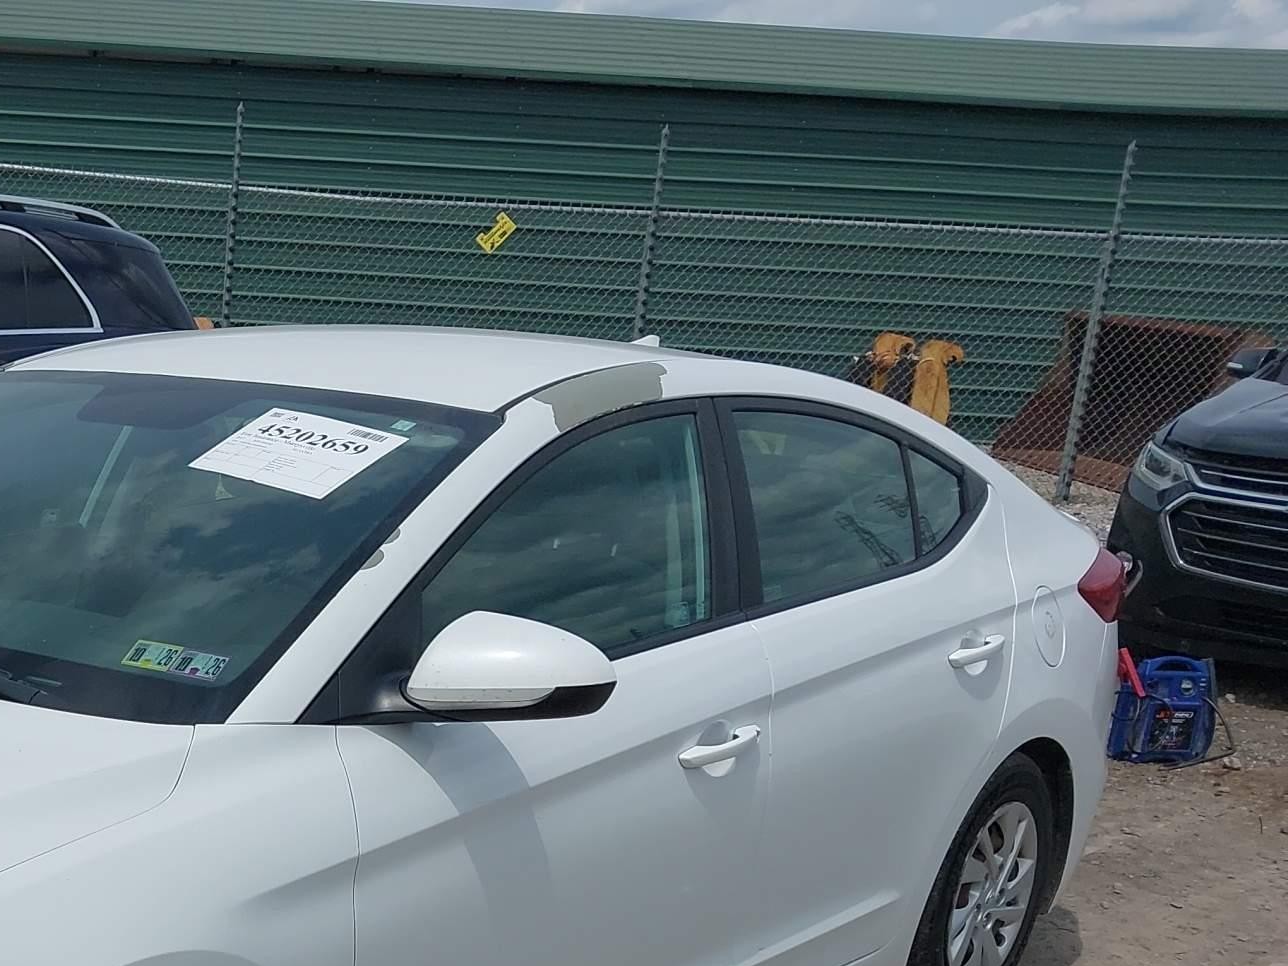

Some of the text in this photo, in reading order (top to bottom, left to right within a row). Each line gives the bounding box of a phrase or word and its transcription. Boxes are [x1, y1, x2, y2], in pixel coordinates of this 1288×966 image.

[258, 423, 369, 455] 45202659
[157, 648, 179, 667] 26
[205, 658, 226, 676] 26
